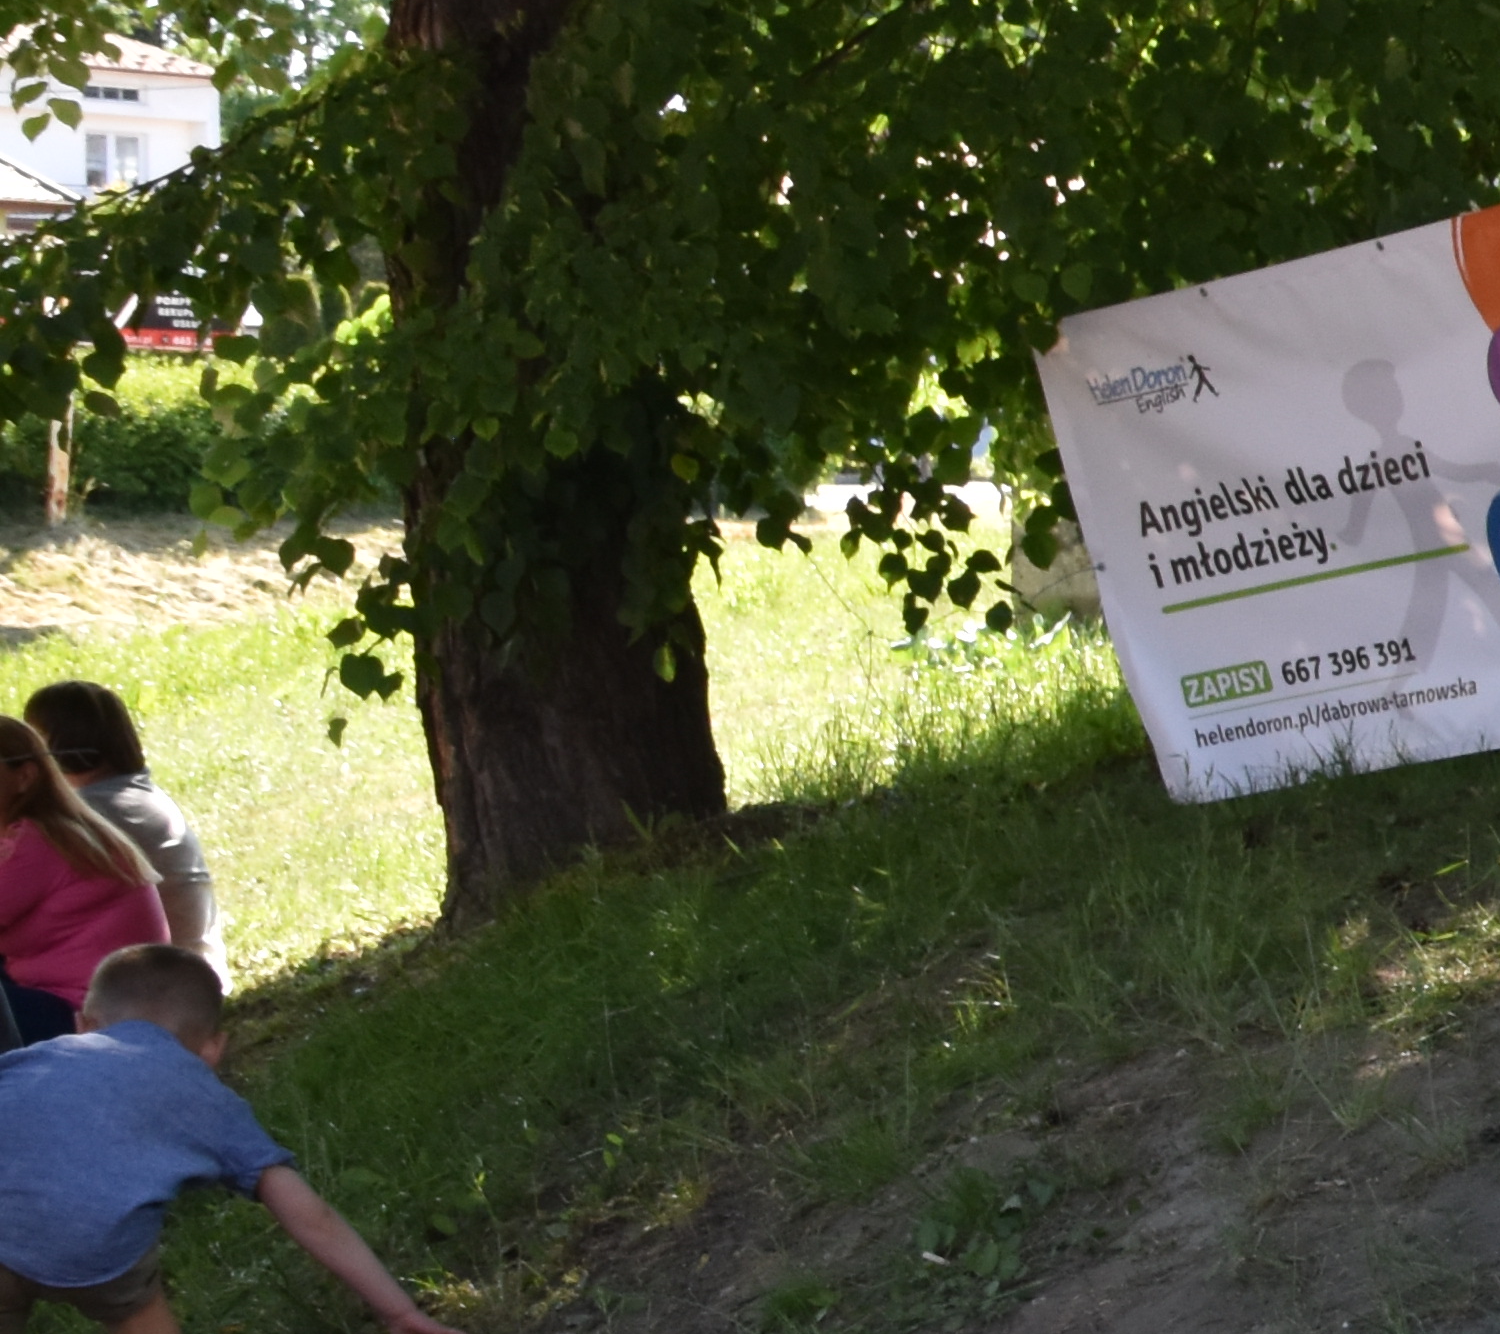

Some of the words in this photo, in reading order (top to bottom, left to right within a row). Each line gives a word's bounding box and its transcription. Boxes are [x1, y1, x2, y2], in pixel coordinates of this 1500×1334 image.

[1086, 373, 1132, 402] Helen
[1131, 365, 1187, 392] Doron
[1136, 385, 1186, 414] English
[1139, 475, 1280, 538] Angielski
[1284, 466, 1334, 505] dla
[1337, 440, 1431, 495] dzieci
[1148, 552, 1164, 589] i
[1170, 522, 1338, 586] młodzieży.
[1185, 665, 1269, 705] ZAPISY
[1281, 656, 1322, 685] 667
[1327, 646, 1371, 677] 396
[1373, 637, 1417, 668] 391
[1194, 677, 1478, 749] helendoron.pl/dabrowa-tarnowska
